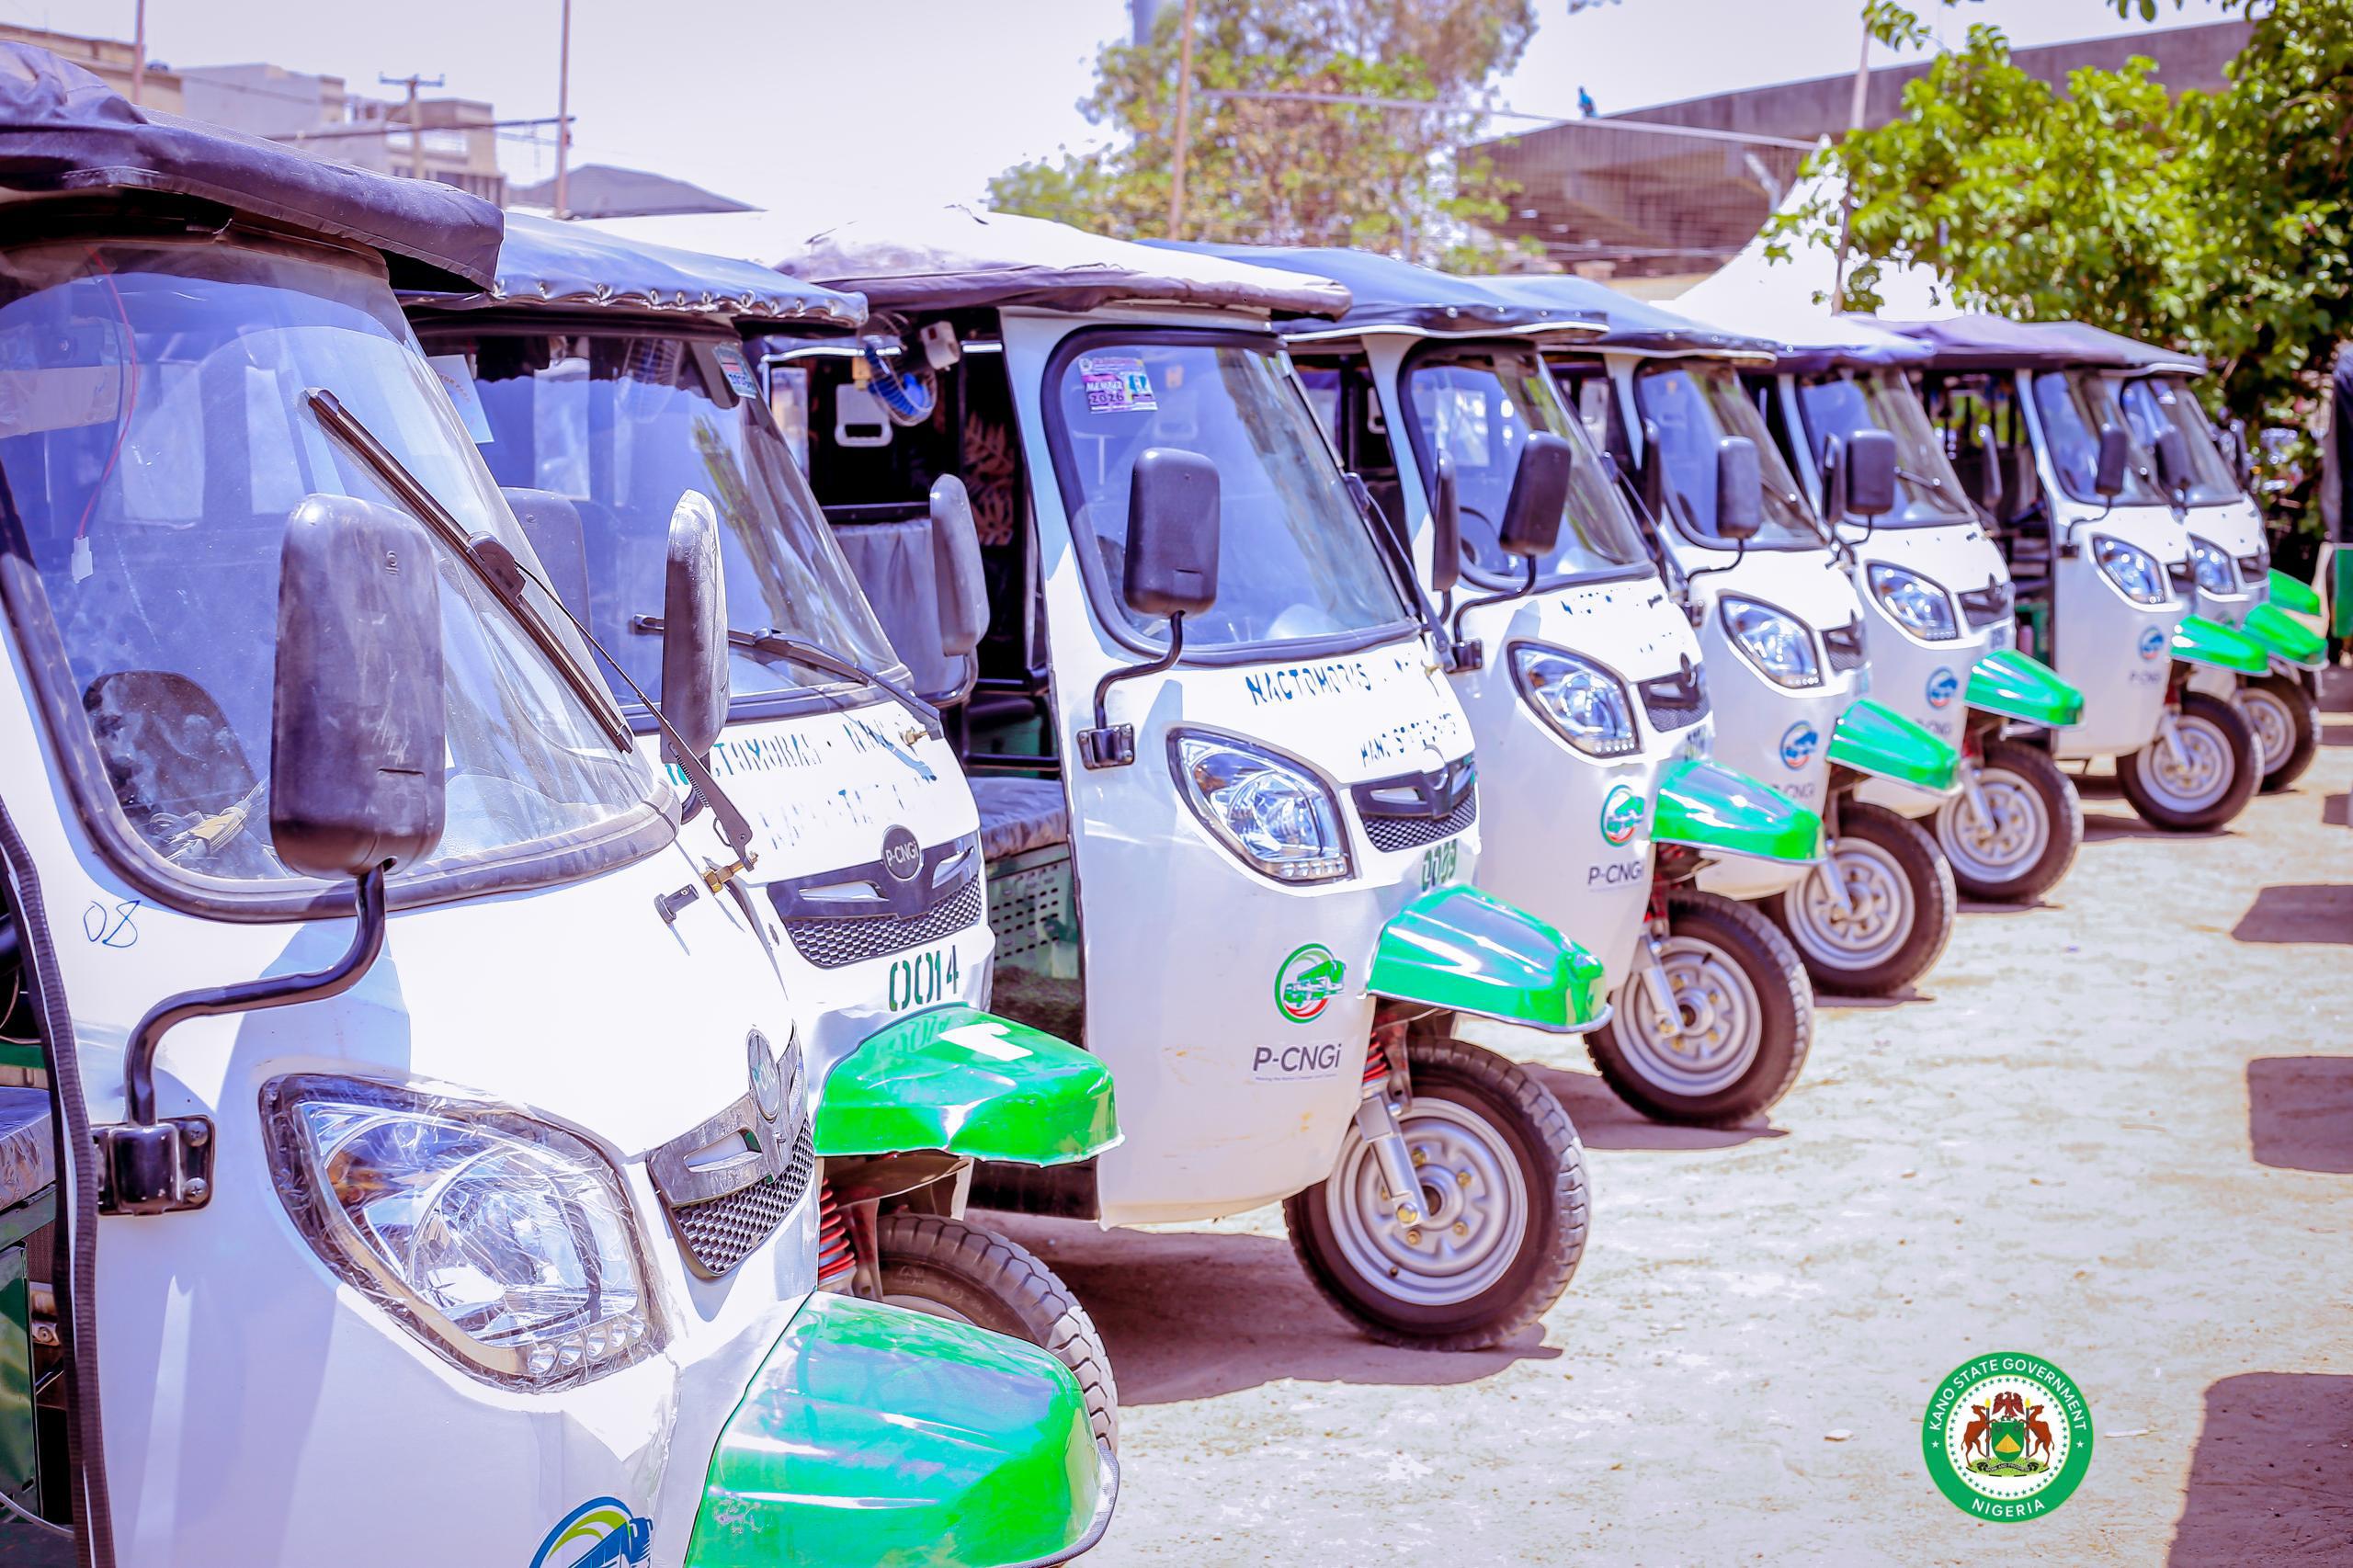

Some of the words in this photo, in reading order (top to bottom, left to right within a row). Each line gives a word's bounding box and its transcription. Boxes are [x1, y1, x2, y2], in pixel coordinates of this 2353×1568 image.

[885, 840, 919, 867] P-CNGi
[83, 900, 141, 949] 08
[888, 944, 960, 1012] 0014
[1253, 1043, 1342, 1072] P-CNGi
